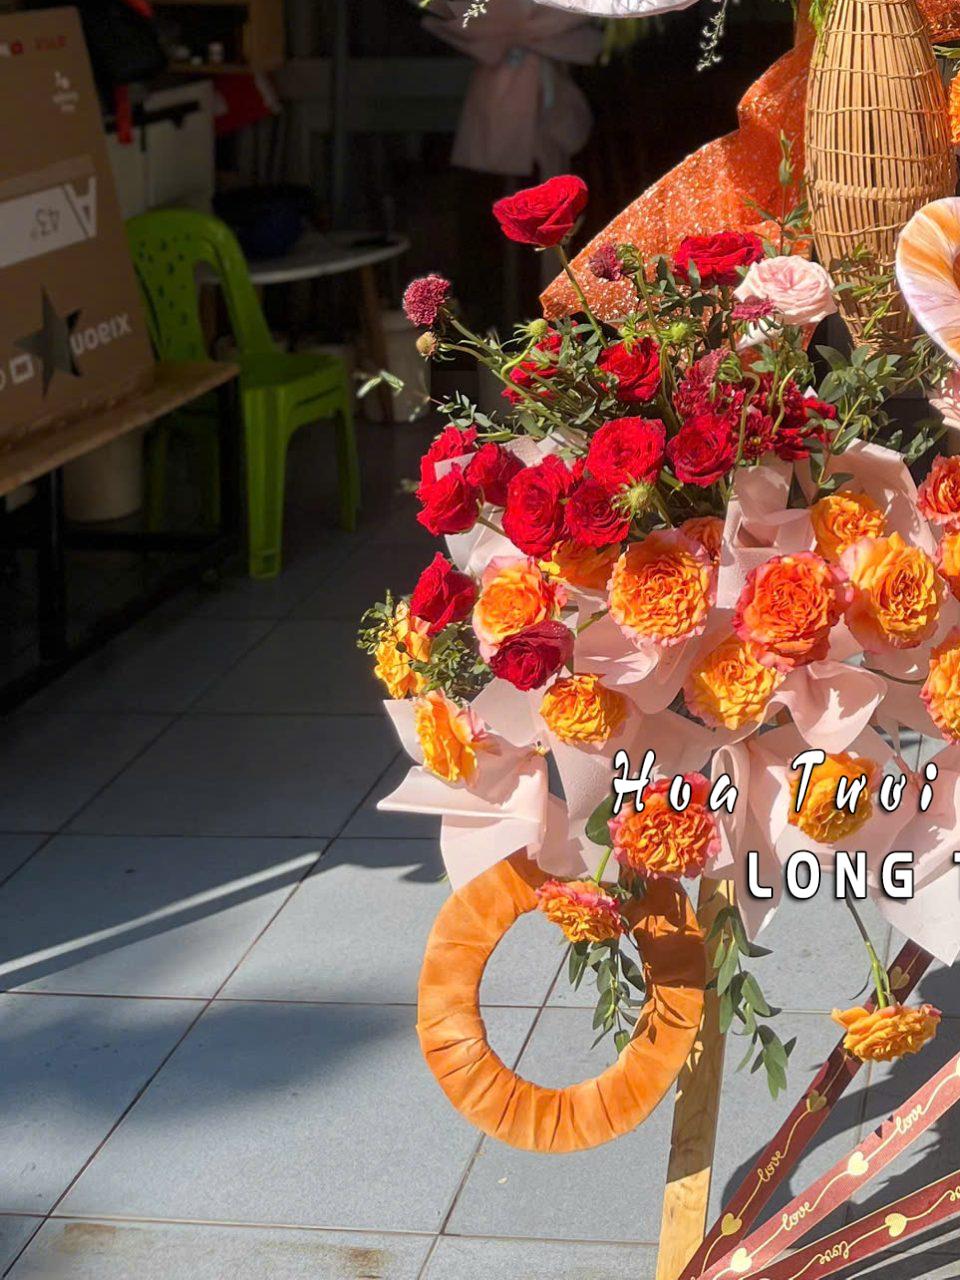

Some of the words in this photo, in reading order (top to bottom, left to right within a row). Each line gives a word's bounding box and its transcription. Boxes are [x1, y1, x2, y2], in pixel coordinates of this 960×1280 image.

[895, 1103, 924, 1135] love
[757, 1150, 783, 1183] love
[781, 1201, 812, 1231] love
[818, 1240, 850, 1266] love
